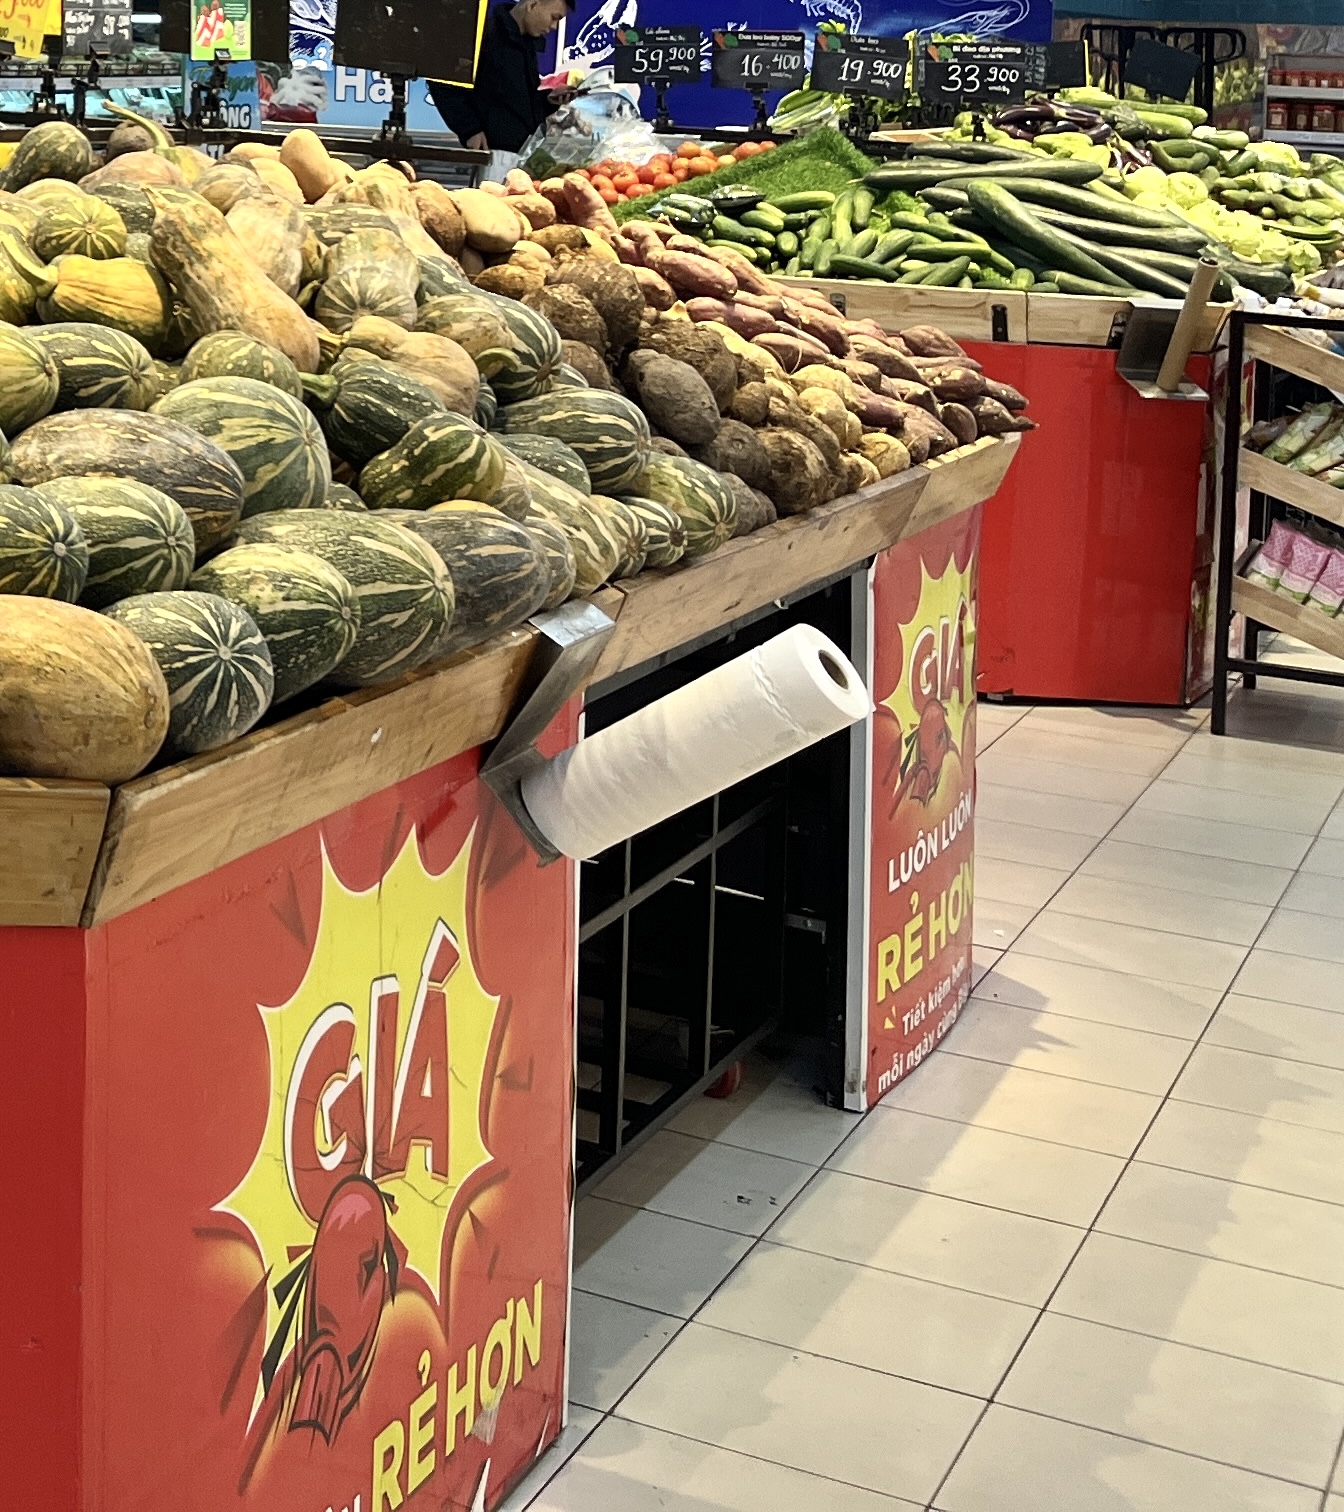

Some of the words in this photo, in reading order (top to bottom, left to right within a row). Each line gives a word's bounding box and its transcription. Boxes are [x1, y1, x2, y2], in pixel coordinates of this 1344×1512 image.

[632, 47, 696, 73] 59.900
[837, 57, 902, 82] 19.900
[941, 64, 1019, 93] 33.900
[888, 829, 938, 893] LUÔN
[941, 789, 972, 852] LUÔN
[876, 890, 924, 1004] RẺ
[902, 996, 926, 1036] Tiết
[282, 916, 461, 1231] GIÁ
[877, 1051, 903, 1094] mỗi
[906, 1024, 934, 1069] ngày
[372, 1349, 438, 1512] RẺ
[445, 1279, 542, 1457] HƠN
